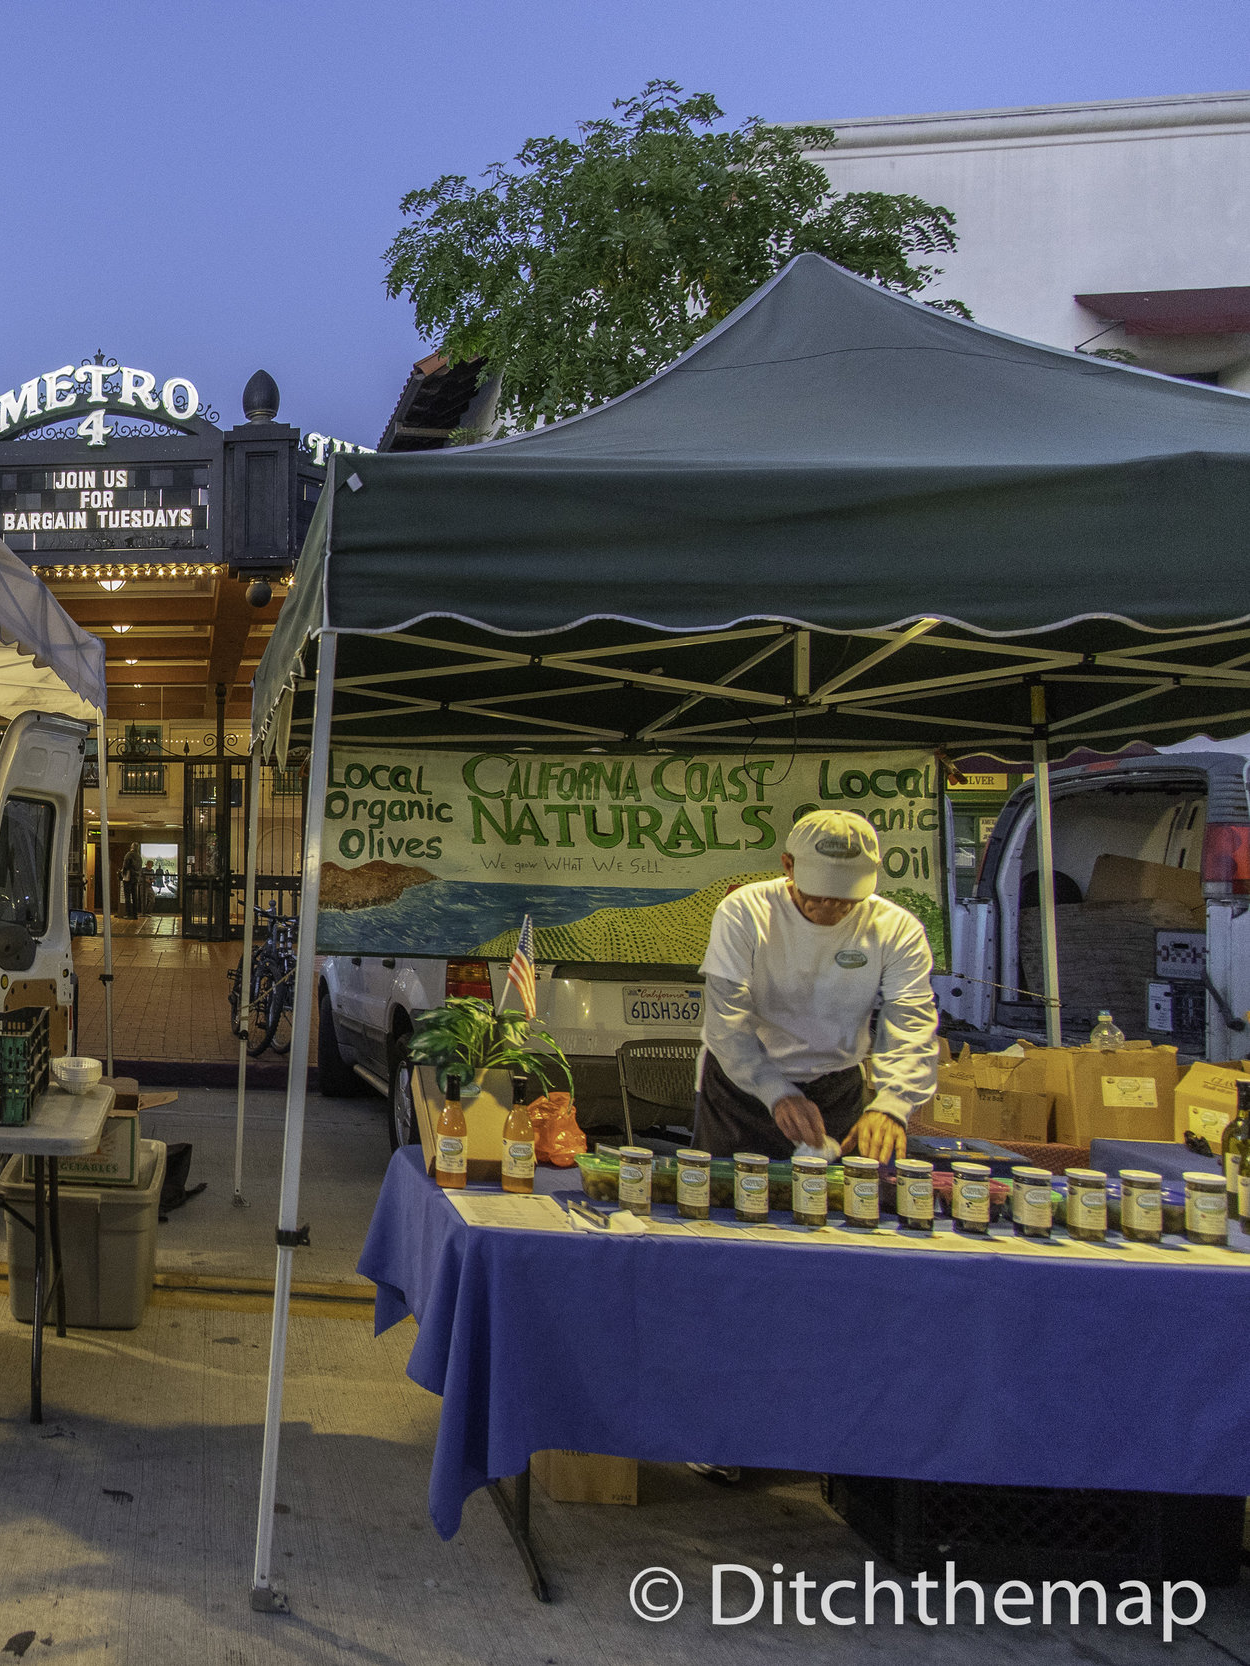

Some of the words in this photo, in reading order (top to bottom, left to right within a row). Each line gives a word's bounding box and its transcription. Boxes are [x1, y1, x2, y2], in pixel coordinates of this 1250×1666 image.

[77, 409, 114, 446] 4
[55, 470, 96, 489] JOIN
[103, 470, 128, 488] US
[80, 491, 114, 508] FOR
[4, 511, 87, 530] BARGAIN
[98, 508, 192, 529] TUESDAYS
[462, 753, 642, 802] CALIFORNIA
[651, 755, 775, 804] COAST
[969, 776, 995, 785] LVER
[324, 790, 453, 829] Organic
[793, 801, 938, 832] anic
[468, 796, 777, 858] NATURALS
[339, 829, 443, 859] Olives
[883, 846, 930, 879] Oil
[640, 989, 689, 1000] California
[631, 1001, 700, 1020] 6DSH369
[60, 1162, 119, 1173] GETABLES
